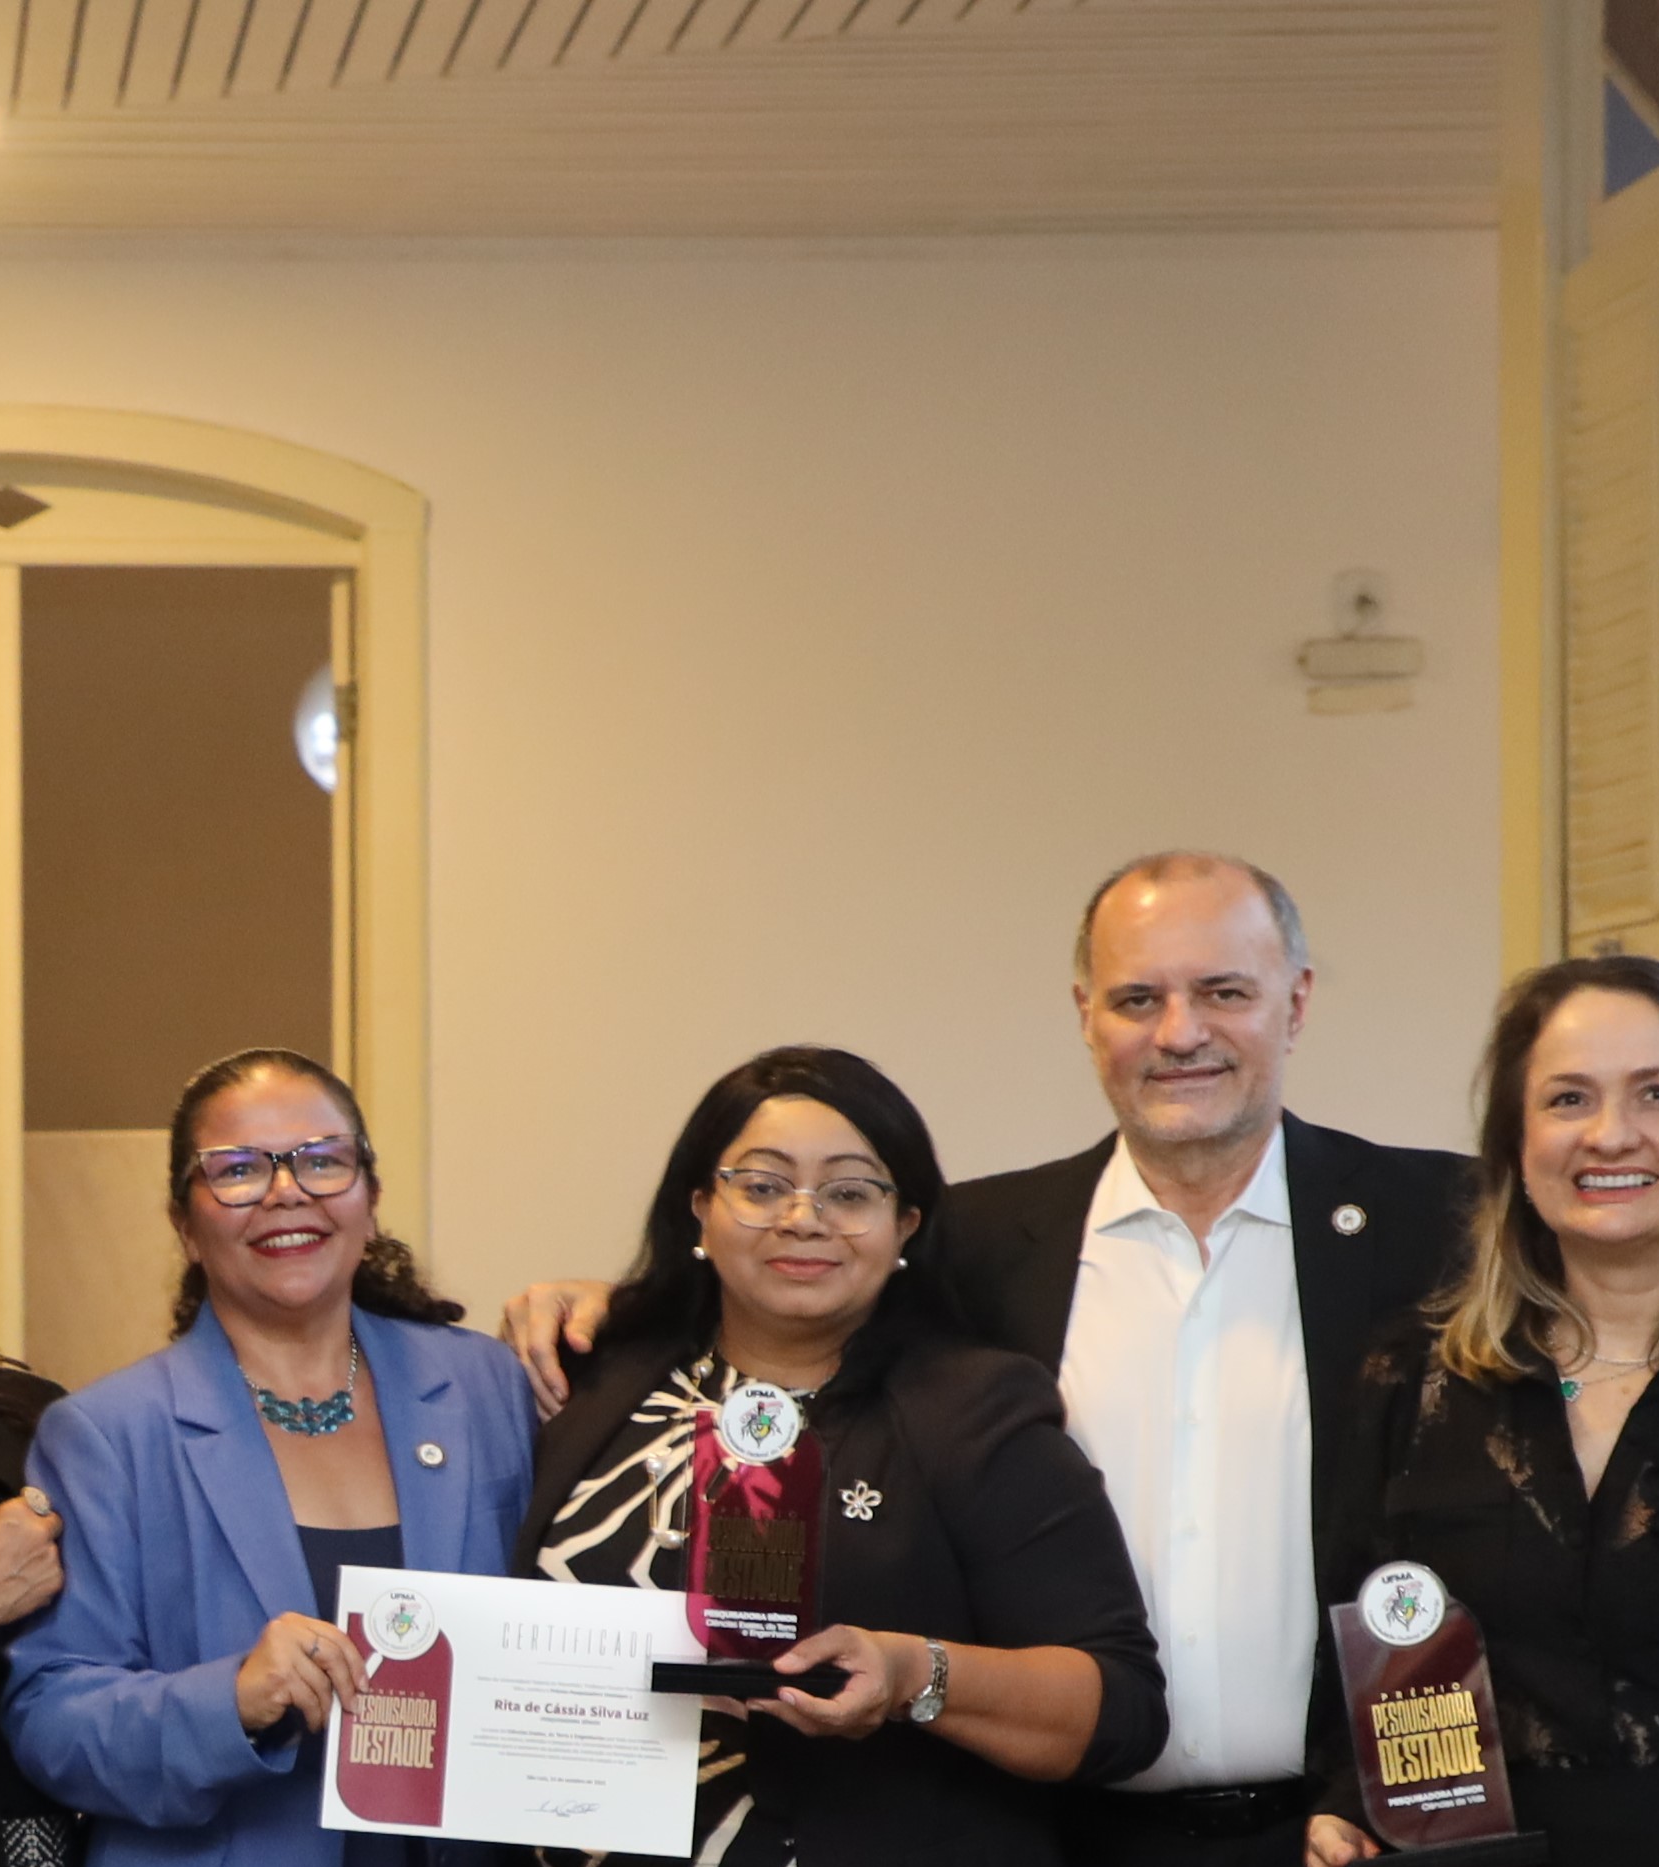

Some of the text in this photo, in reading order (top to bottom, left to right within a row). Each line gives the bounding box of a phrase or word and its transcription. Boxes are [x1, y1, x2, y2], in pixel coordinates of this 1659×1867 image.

[745, 1390, 777, 1399] UFMA
[1381, 1571, 1414, 1585] UFMA
[390, 1593, 416, 1601] UFMA
[502, 1622, 652, 1658] CERTIFICADO
[494, 1699, 650, 1722] Rita de Cássia Silva Luz
[1371, 1690, 1478, 1738] PESQUISADORA
[350, 1723, 436, 1769] DESTAQUE
[1377, 1725, 1486, 1786] DESTAQUE
